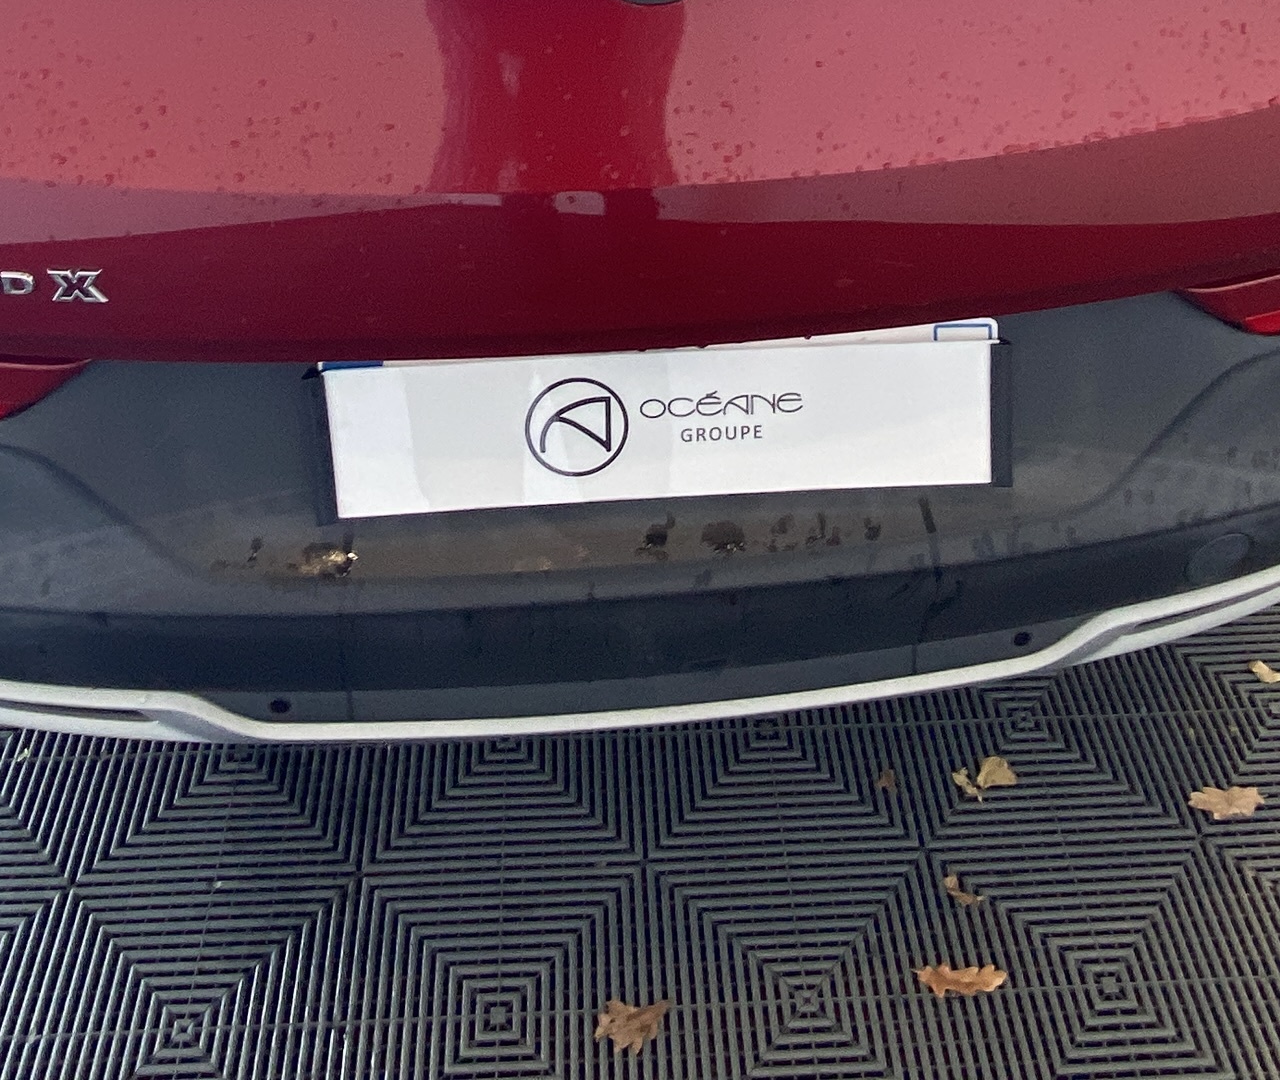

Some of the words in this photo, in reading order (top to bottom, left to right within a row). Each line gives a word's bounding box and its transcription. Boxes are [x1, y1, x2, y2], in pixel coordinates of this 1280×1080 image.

[47, 268, 109, 303] X
[640, 390, 803, 418] OCÉANE
[680, 425, 763, 443] GROUPE
